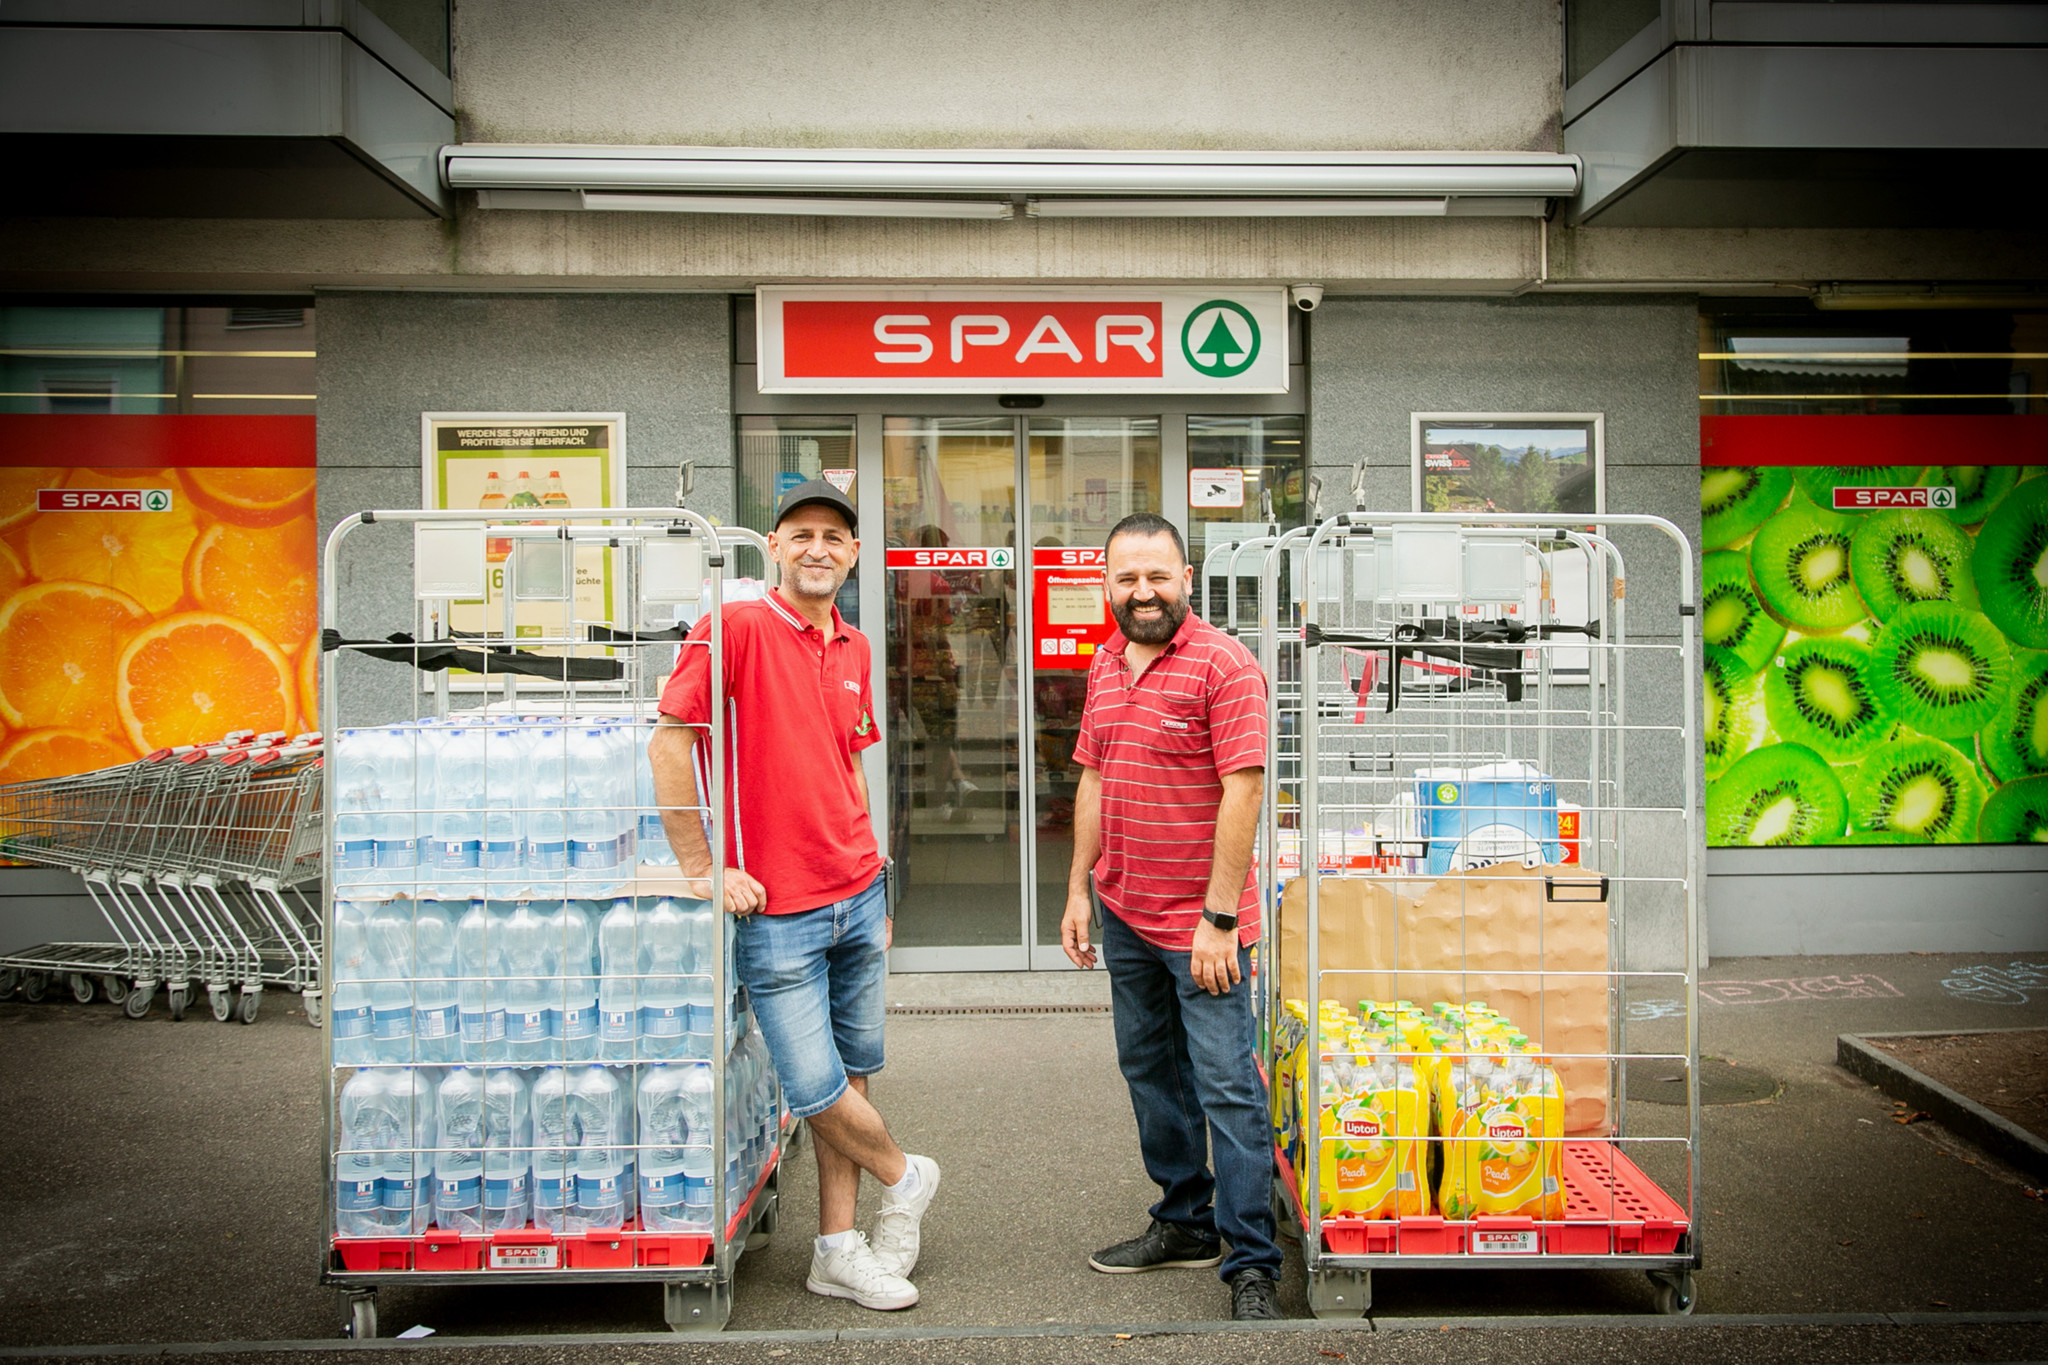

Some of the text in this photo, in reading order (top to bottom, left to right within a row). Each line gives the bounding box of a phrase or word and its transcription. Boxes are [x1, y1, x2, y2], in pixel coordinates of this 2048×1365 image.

[873, 314, 1156, 364] SPAR
[457, 428, 589, 438] WERDEN SIE SPAR FRIEND UND
[461, 437, 586, 446] PROFITIEREN SIE MEHRFACH.
[1425, 459, 1452, 468] SWISS
[62, 493, 140, 507] SPAR
[1856, 491, 1927, 504] SPAR
[915, 551, 984, 565] SPAR
[1061, 551, 1107, 564] SPA
[1347, 1122, 1378, 1135] Lipton
[1491, 1127, 1522, 1138] Lipton
[1340, 1164, 1367, 1177] Peach
[1484, 1166, 1511, 1180] Peach
[1487, 1234, 1519, 1242] SPAR
